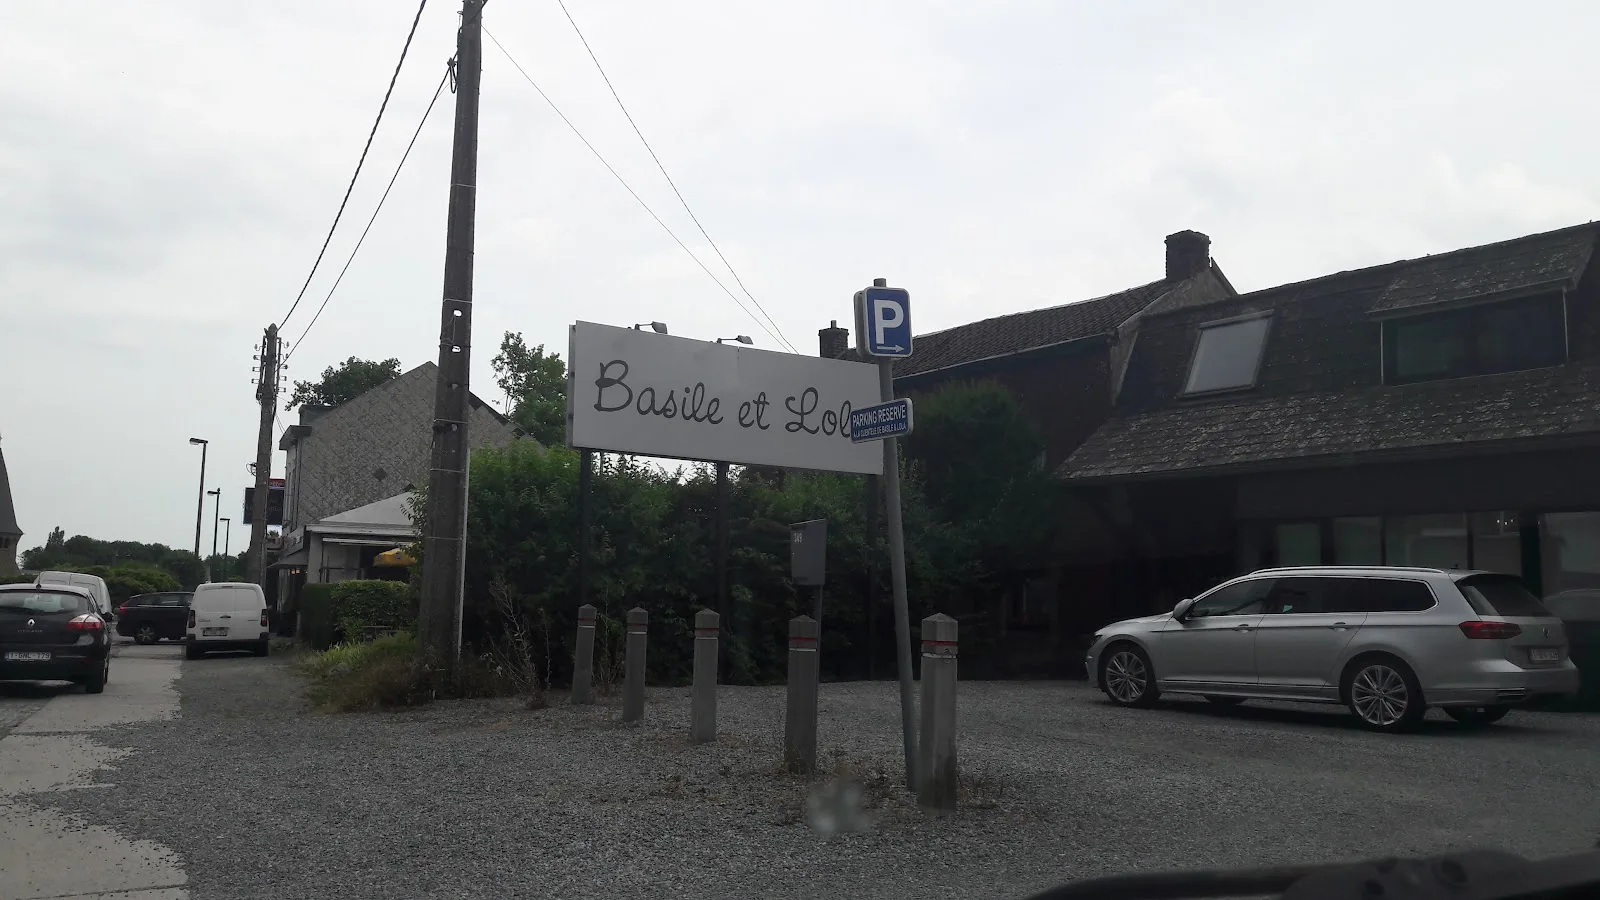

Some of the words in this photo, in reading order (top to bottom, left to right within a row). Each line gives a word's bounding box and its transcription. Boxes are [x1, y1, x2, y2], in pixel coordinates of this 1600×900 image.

[874, 299, 904, 344] P
[594, 359, 723, 425] Basile
[738, 391, 770, 430] et
[785, 386, 851, 438] Lol
[853, 411, 877, 428] PARKING
[882, 424, 893, 433] BASILE
[897, 422, 906, 431] LOLA
